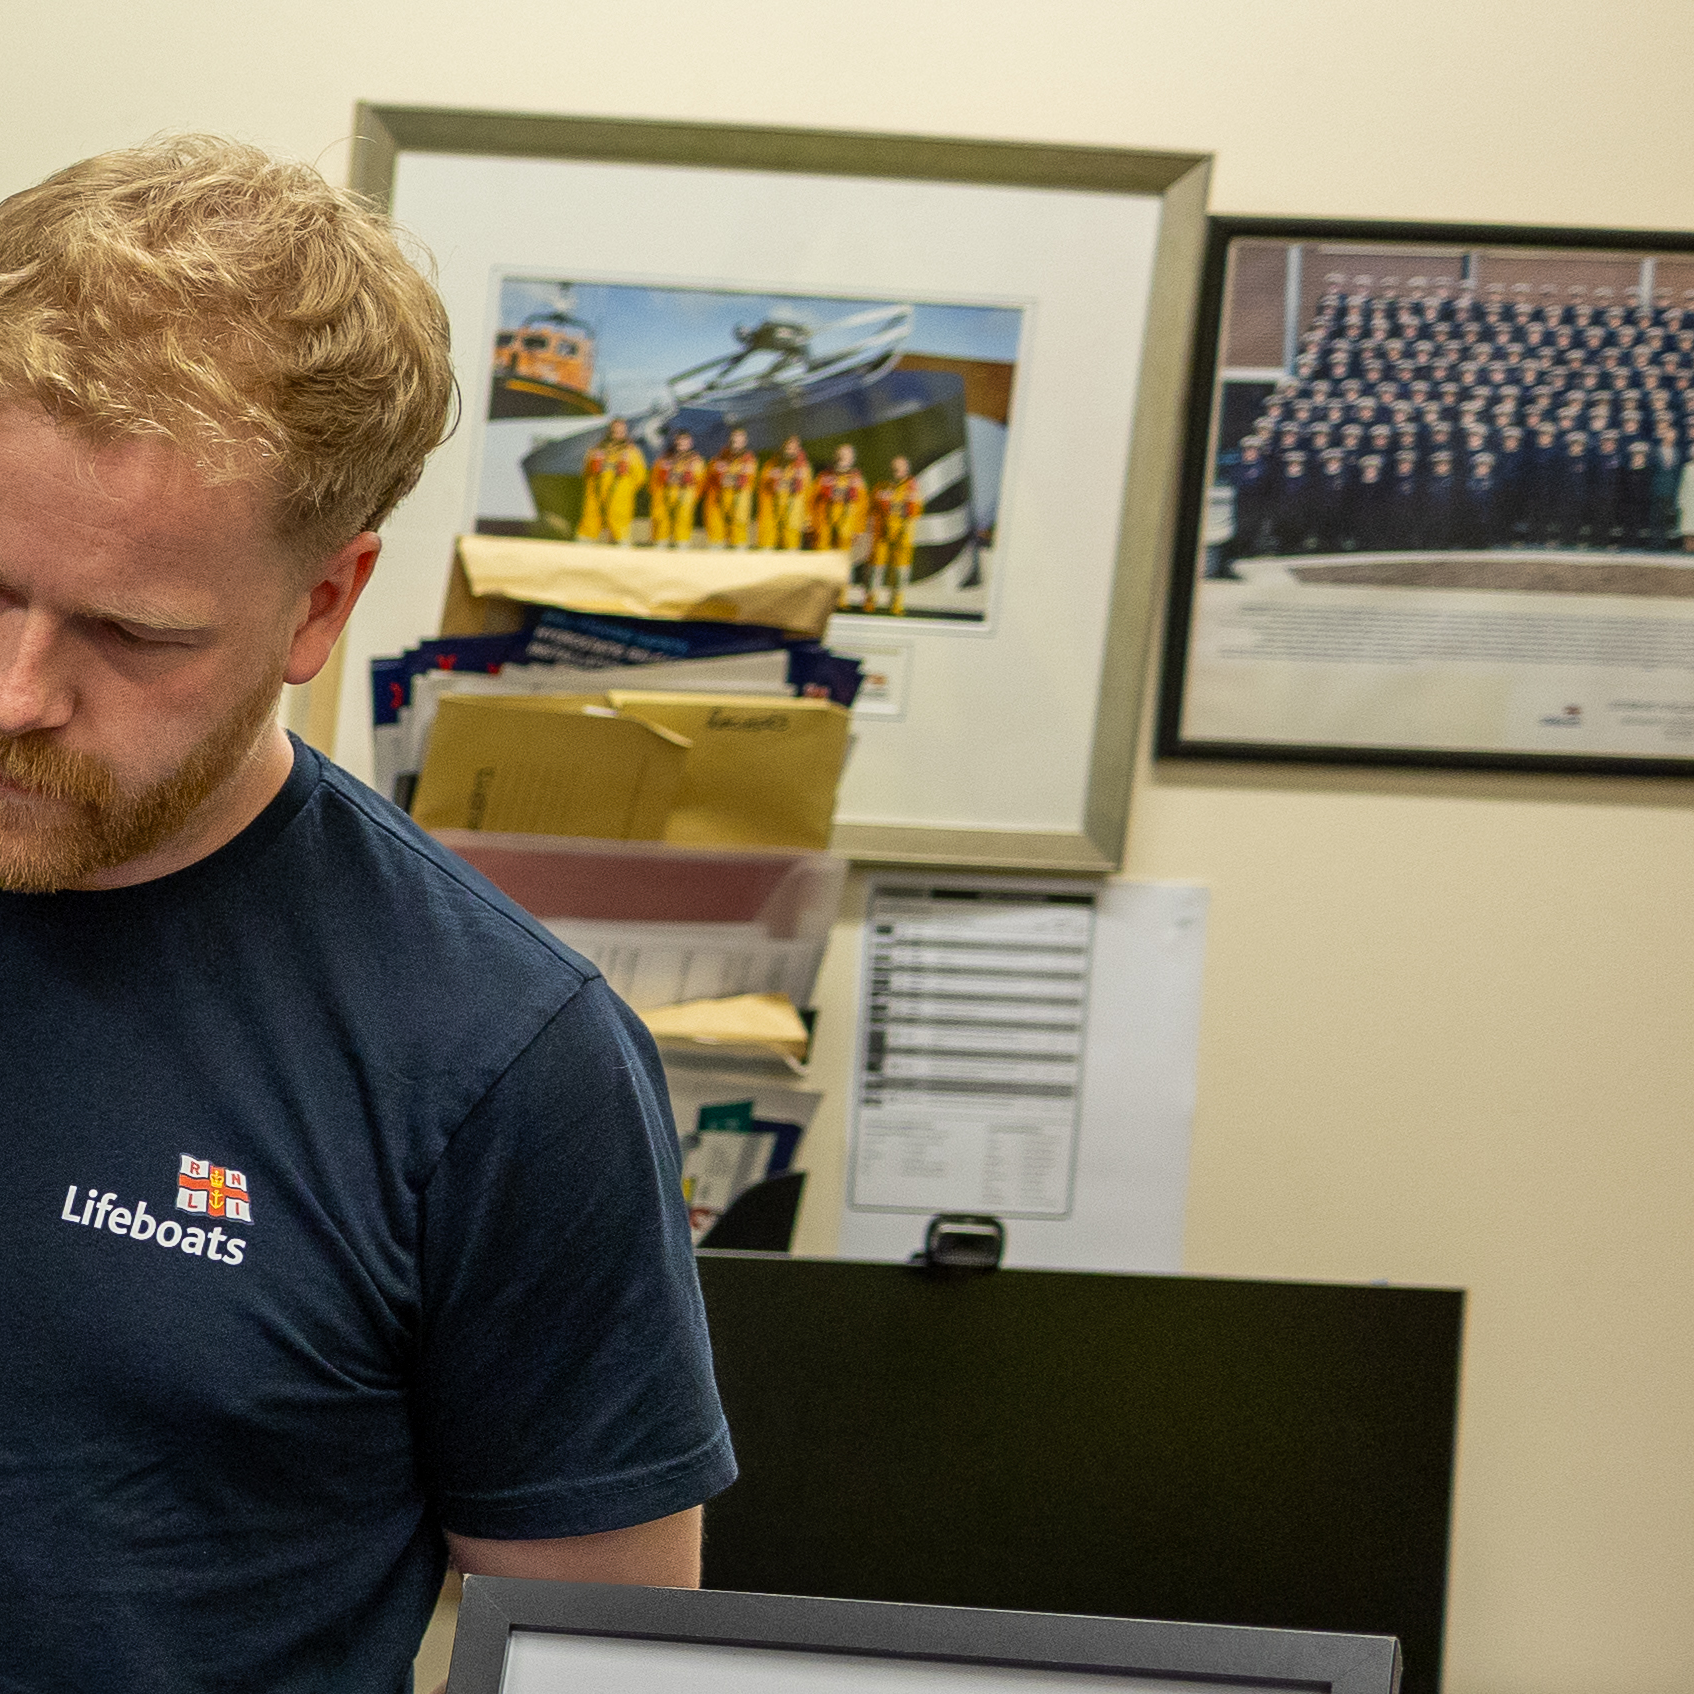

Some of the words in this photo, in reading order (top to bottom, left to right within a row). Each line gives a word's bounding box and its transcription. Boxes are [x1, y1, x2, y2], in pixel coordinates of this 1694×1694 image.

[190, 1160, 201, 1176] R
[231, 1173, 241, 1186] N
[188, 1193, 198, 1209] L
[61, 1185, 247, 1266] Lifeboats
